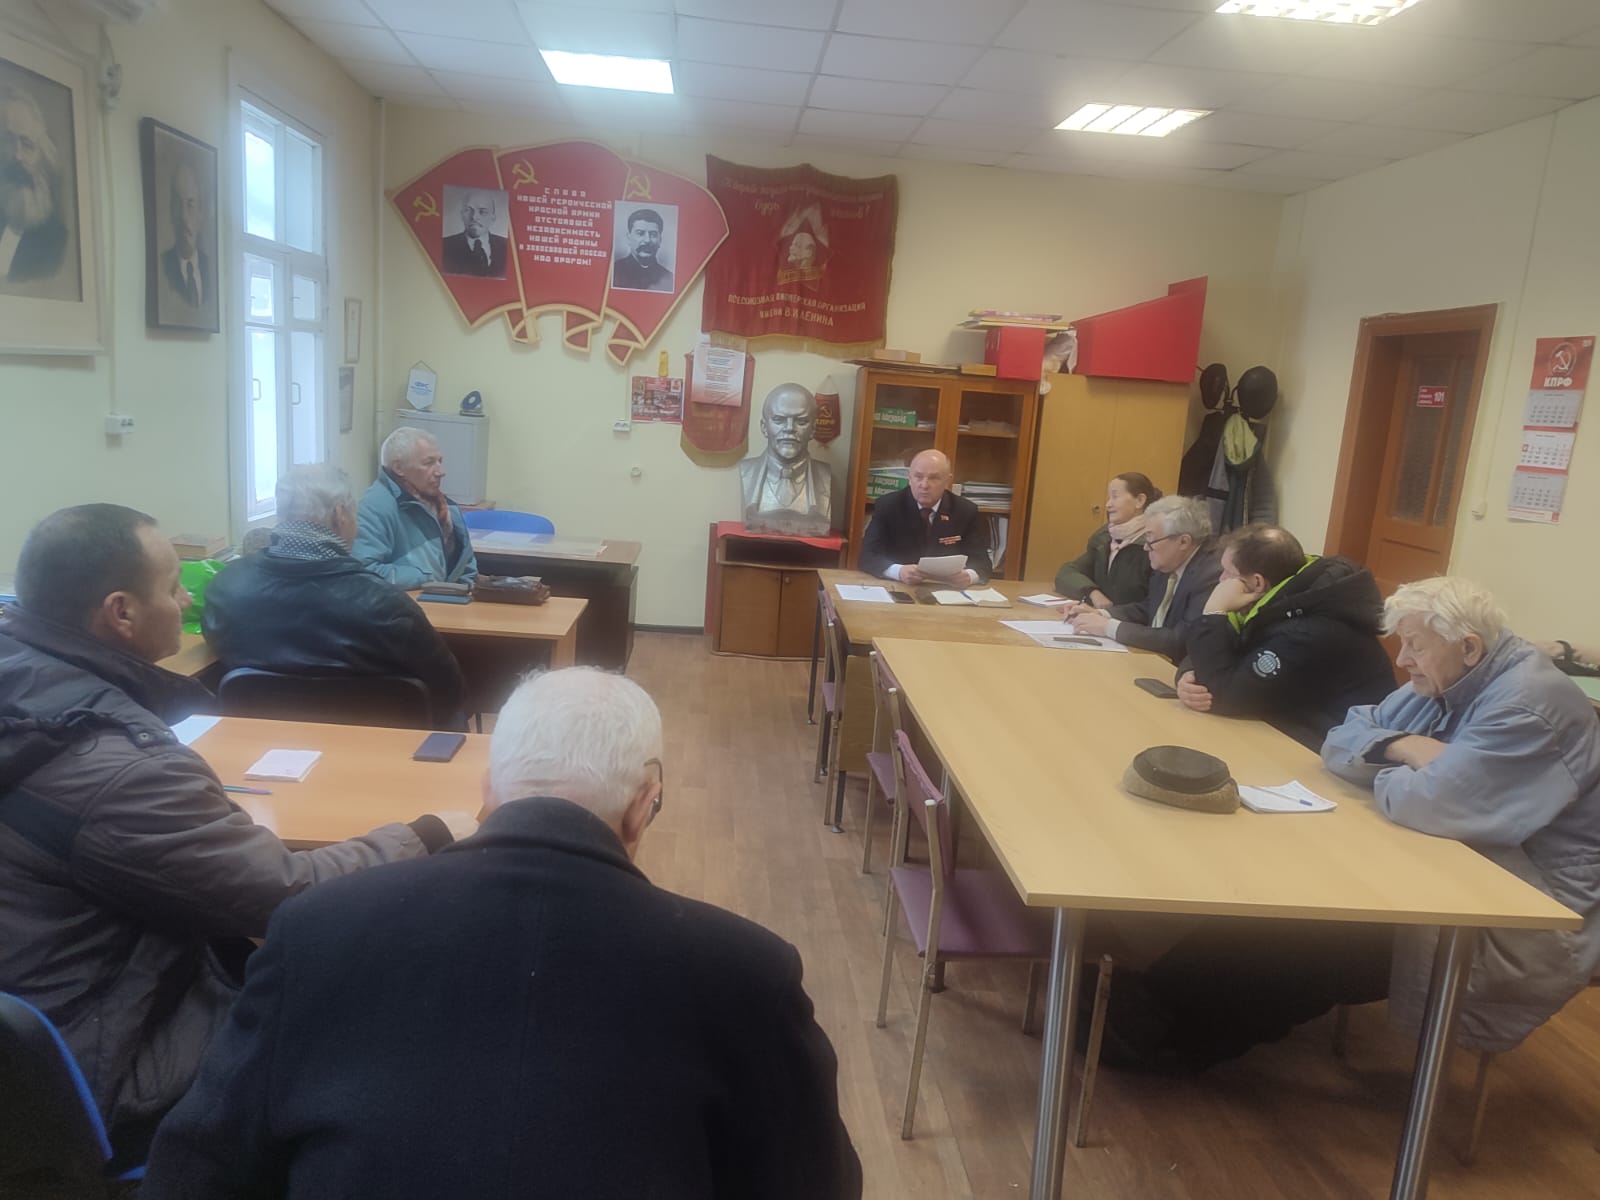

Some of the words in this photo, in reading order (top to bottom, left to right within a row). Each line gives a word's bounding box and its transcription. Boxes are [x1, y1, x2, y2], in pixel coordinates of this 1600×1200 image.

[516, 194, 548, 204] НАШЕЙ
[550, 197, 613, 209] ГЕРОИЧЕСКОЙ
[528, 205, 569, 216] КРАСНОЙ
[571, 209, 601, 218] АРМИИ
[535, 216, 593, 227] ОТСТОЯВШЕЙ
[526, 225, 601, 238] НЕЗАВИСИМОСТЬ
[529, 234, 560, 244] НАШЕЙ
[562, 237, 599, 247] РОДИНЫ
[534, 254, 551, 262] НАД
[553, 256, 592, 266] ВРАГОМ!
[1543, 376, 1573, 387] КПРФ
